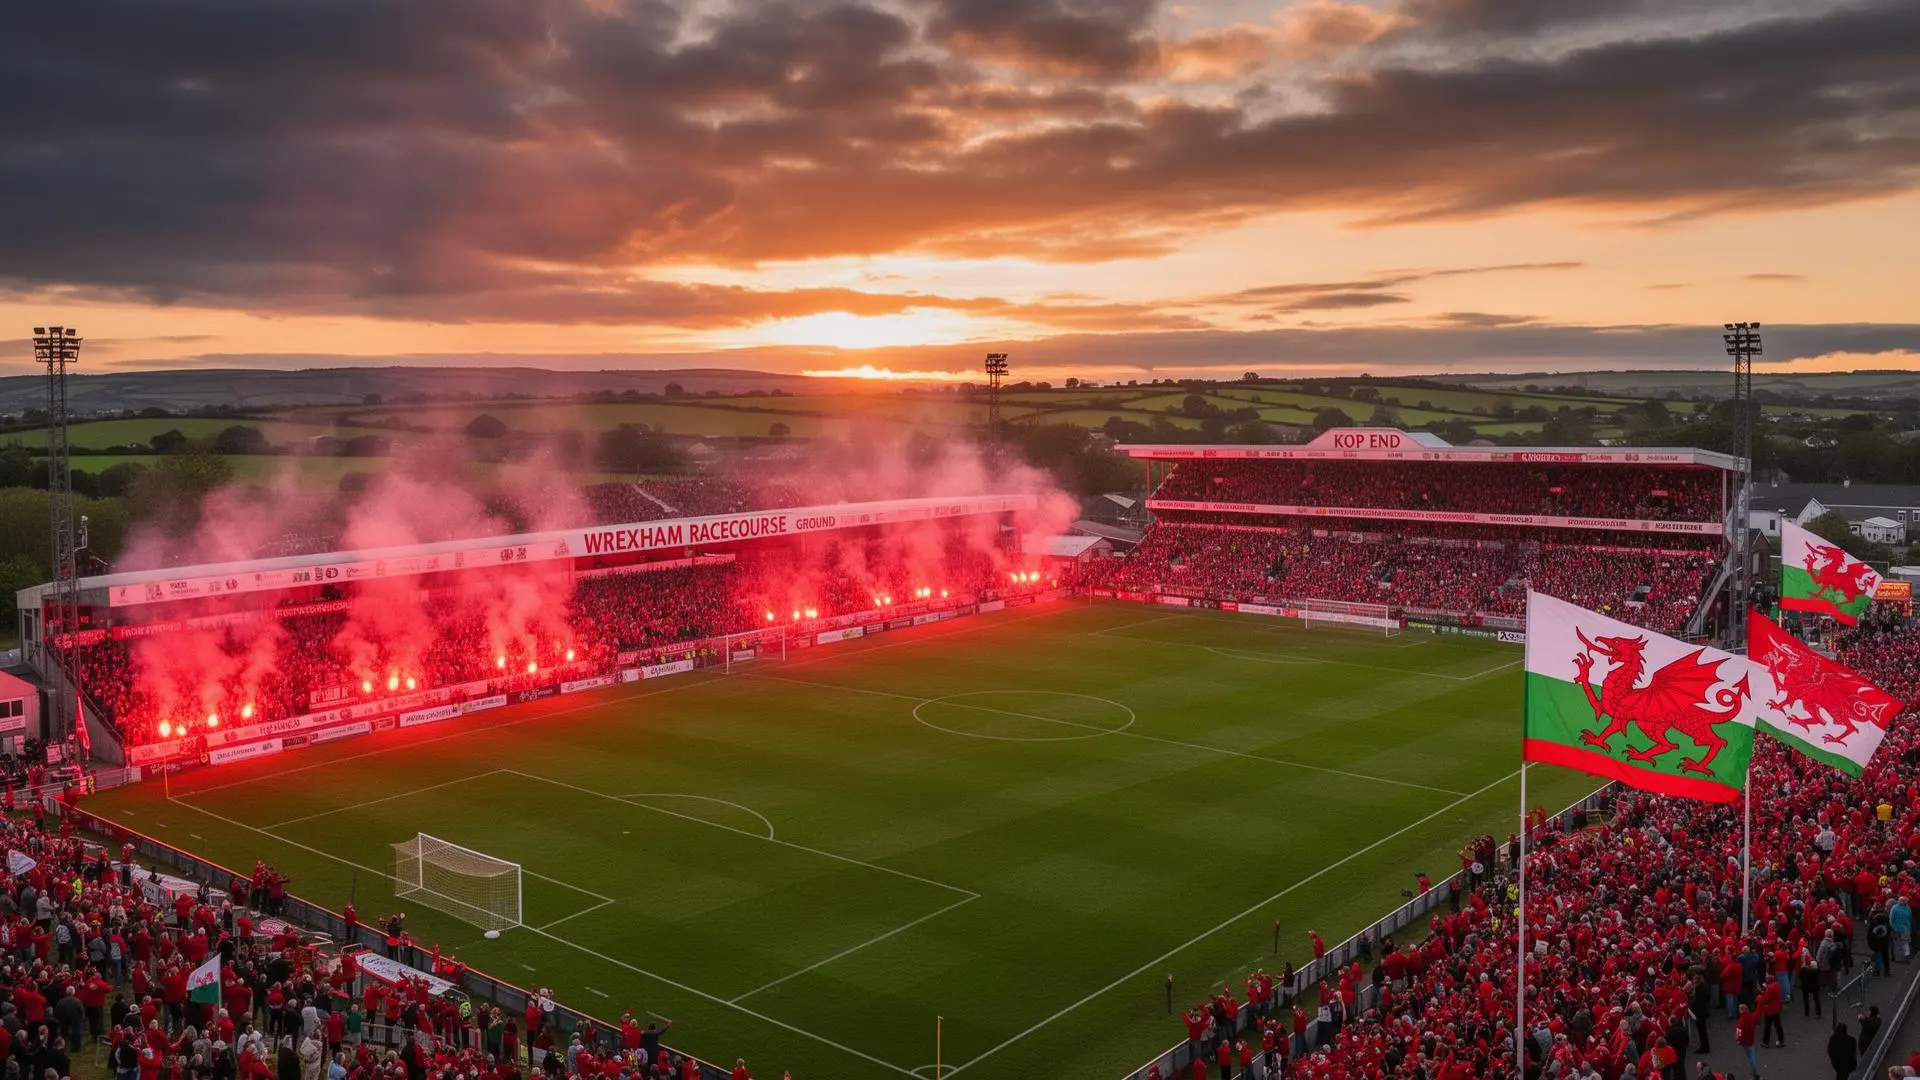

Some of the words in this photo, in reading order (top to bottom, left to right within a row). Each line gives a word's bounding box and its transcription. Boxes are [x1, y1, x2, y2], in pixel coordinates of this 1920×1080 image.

[1334, 434, 1365, 449] KOP
[1370, 434, 1401, 449] END
[584, 525, 683, 554] WREXHAM
[690, 515, 787, 543] RACECOURSE
[796, 516, 836, 530] GROUND
